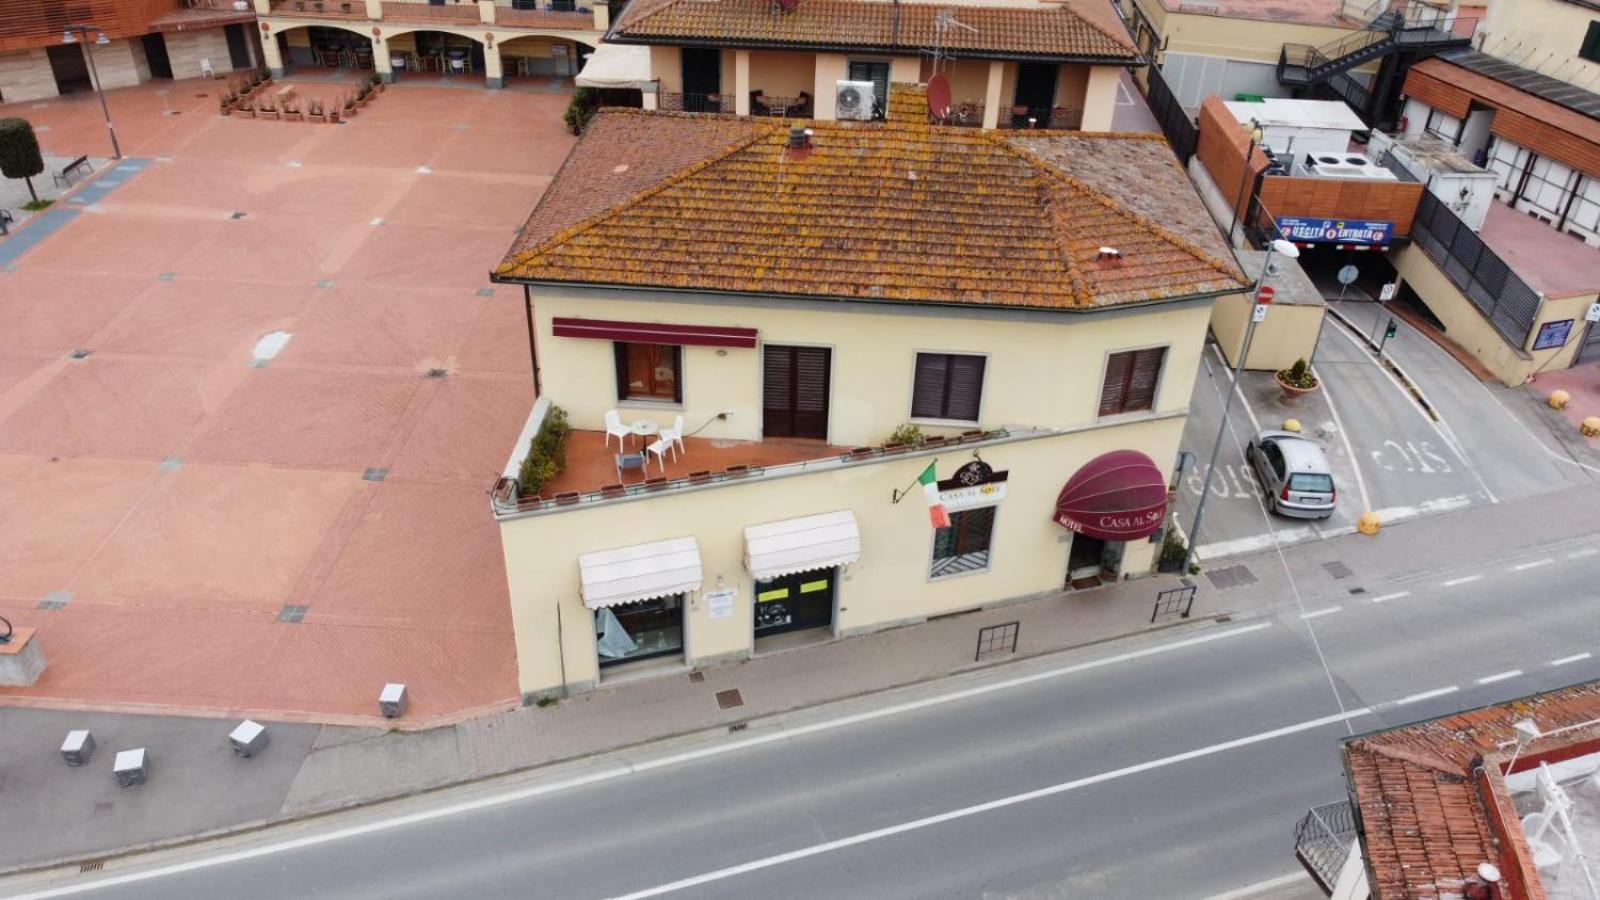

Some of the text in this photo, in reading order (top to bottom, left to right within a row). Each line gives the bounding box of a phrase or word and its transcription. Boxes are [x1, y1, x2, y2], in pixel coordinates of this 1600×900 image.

[1292, 225, 1325, 239] USCITA
[1337, 227, 1373, 239] ENTRATA
[1059, 512, 1084, 533] HOTEL
[1100, 515, 1131, 529] CASA
